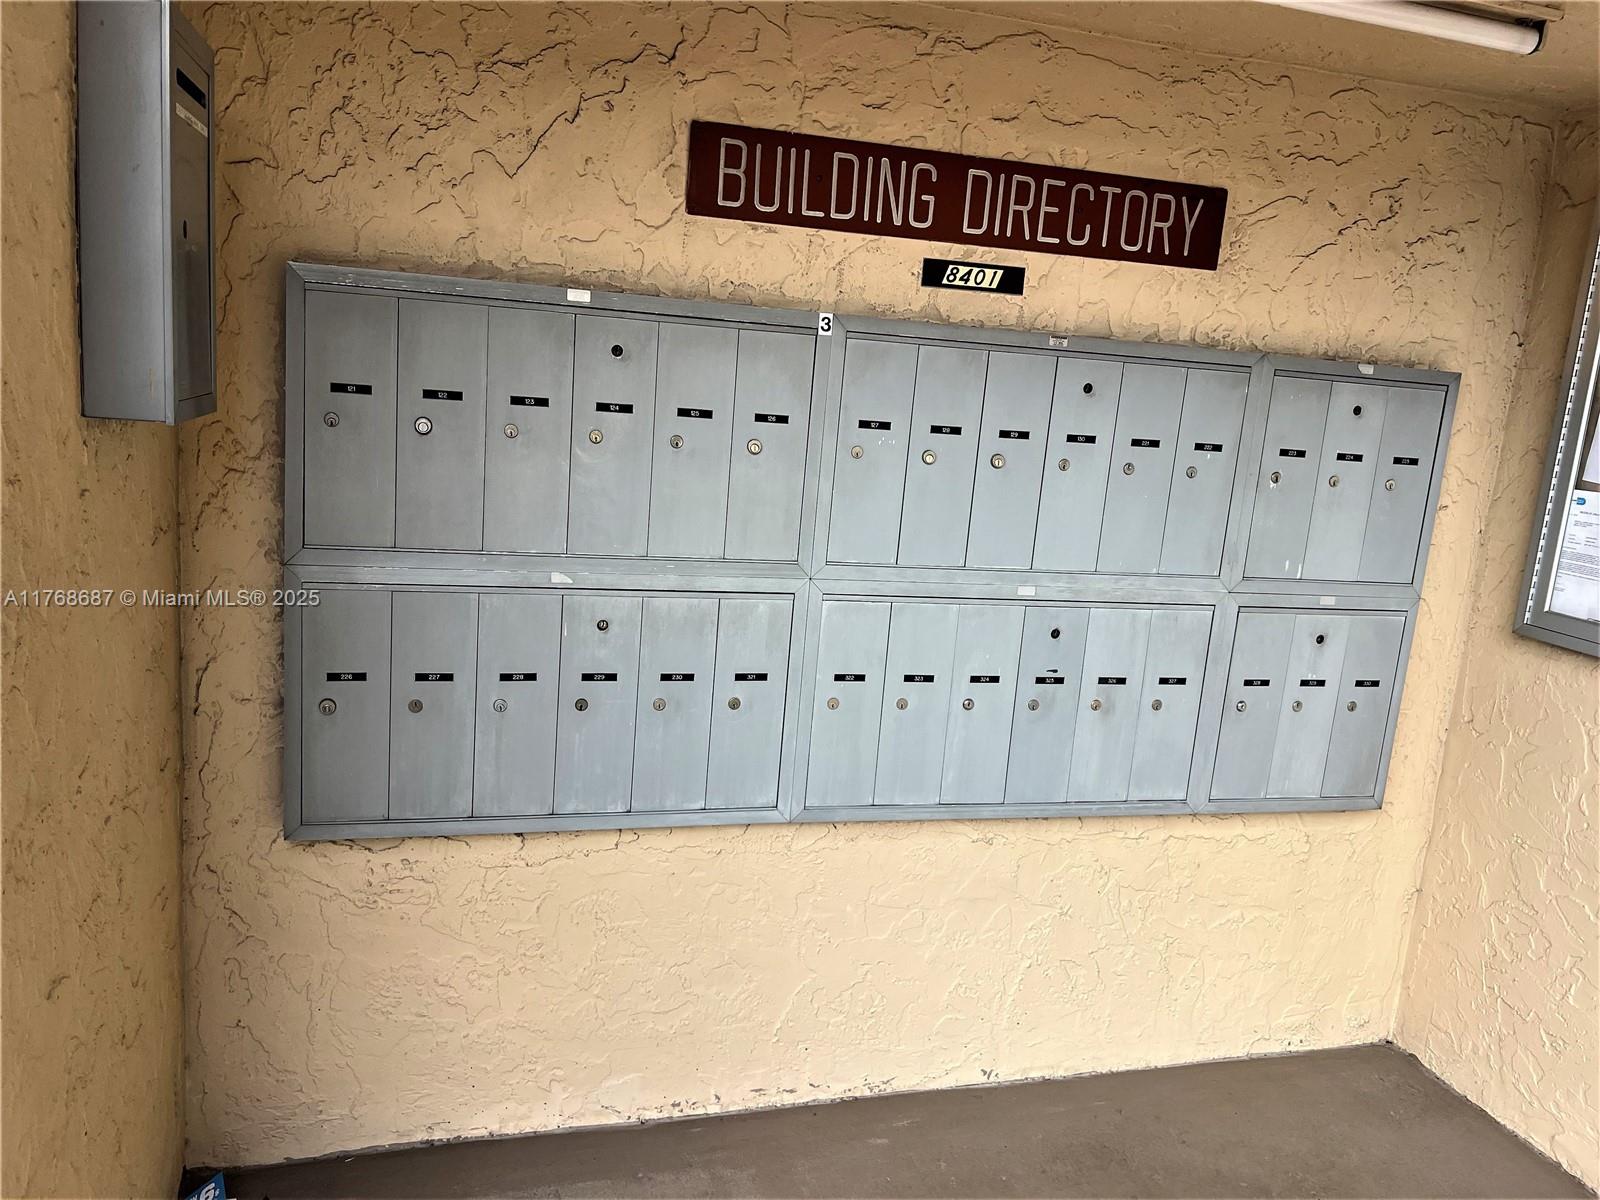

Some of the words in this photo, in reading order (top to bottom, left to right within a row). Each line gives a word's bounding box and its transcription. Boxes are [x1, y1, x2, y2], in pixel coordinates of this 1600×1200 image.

[717, 137, 937, 229] BUILDING
[962, 168, 1204, 257] DIRECTORY
[946, 266, 998, 287] 8401
[820, 316, 832, 332] 3
